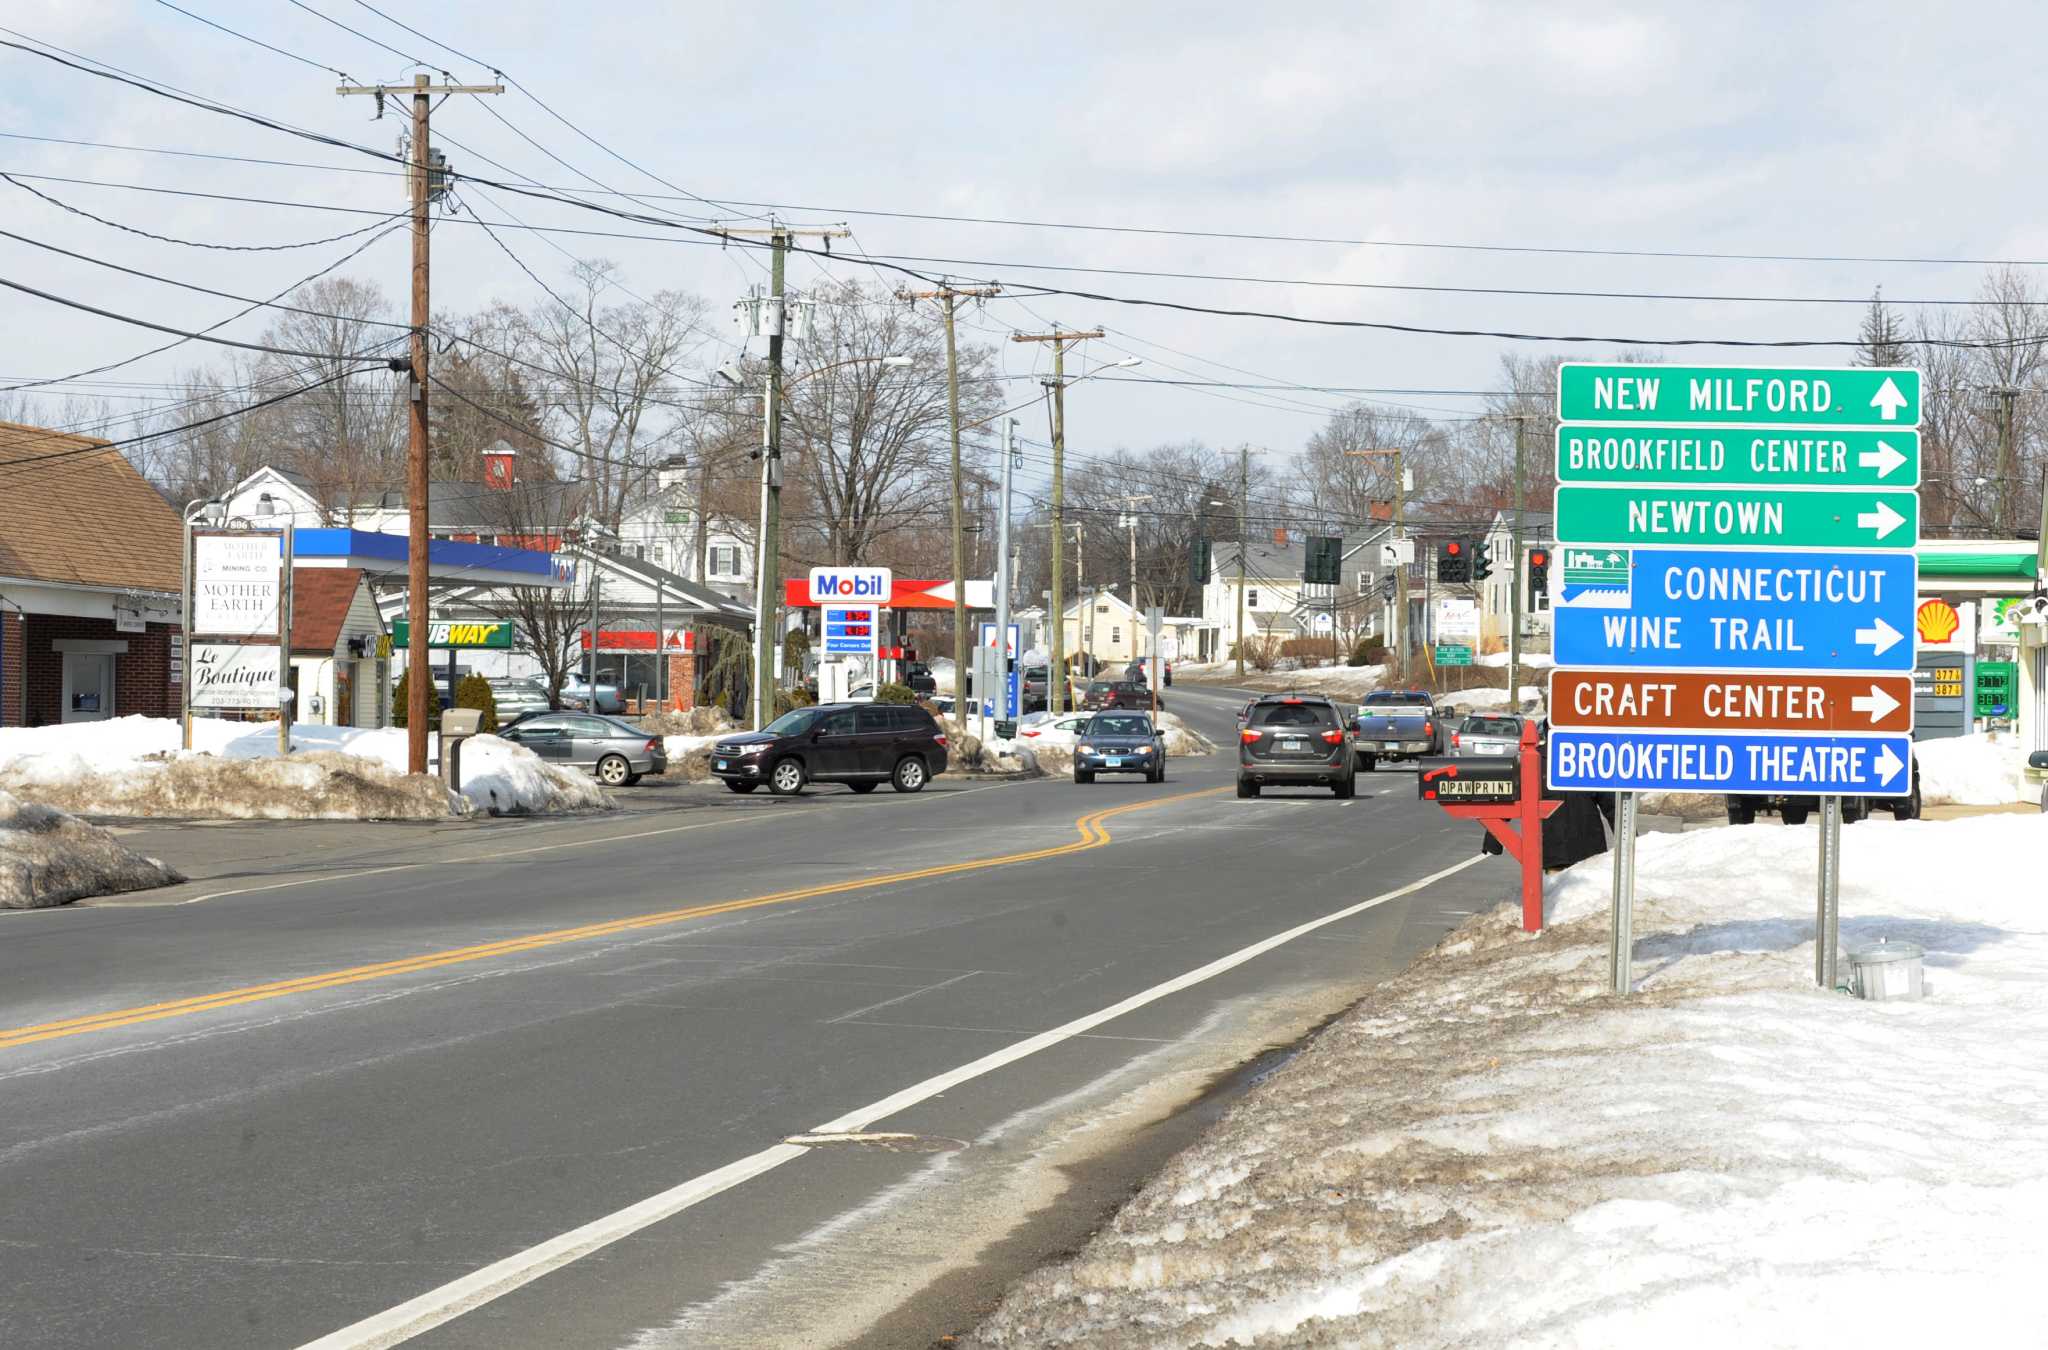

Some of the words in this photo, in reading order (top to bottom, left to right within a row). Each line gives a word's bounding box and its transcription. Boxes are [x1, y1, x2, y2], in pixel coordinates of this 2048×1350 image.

[1594, 377, 1660, 410] NEW
[1690, 378, 1831, 412] MILFORD
[1569, 438, 1725, 471] BROOKFIELD
[1751, 439, 1847, 473] CENTER
[1628, 500, 1783, 534] NEWTOWN
[203, 584, 271, 597] MOTHER
[817, 575, 882, 595] Mobil
[1664, 566, 1886, 604] CONNECTICUT
[211, 599, 263, 611] EARTH
[1603, 615, 1682, 650] WINE
[1710, 617, 1804, 652] TRAIL
[197, 647, 218, 664] Le
[194, 665, 276, 687] Boutique
[1936, 684, 1953, 696] 387
[1574, 682, 1677, 717] CRAFT
[1703, 683, 1825, 719] CENTER
[1558, 741, 1734, 781] BROOKFIELD
[1745, 745, 1866, 783] THEATRE
[1441, 782, 1446, 792] A
[1450, 782, 1471, 793] PAW
[1475, 782, 1512, 793] PRINT
